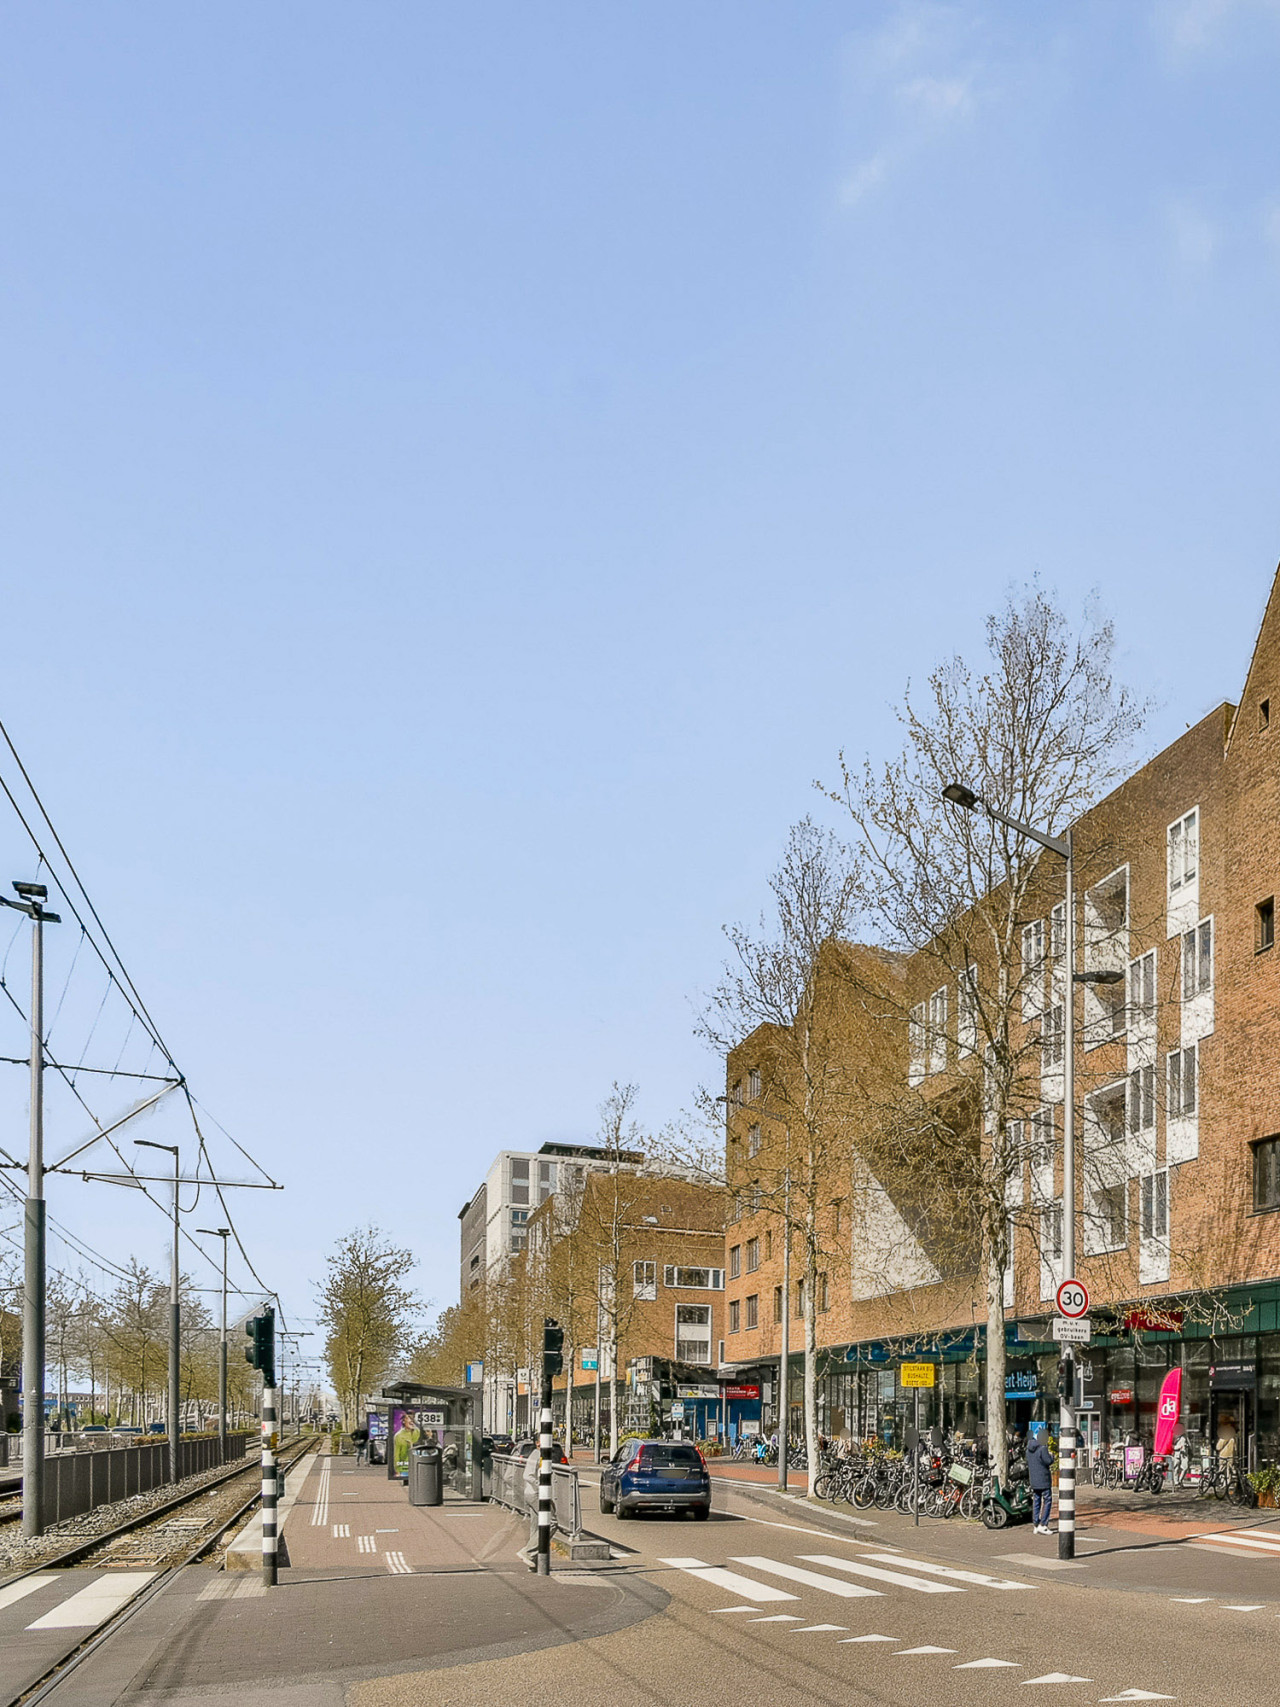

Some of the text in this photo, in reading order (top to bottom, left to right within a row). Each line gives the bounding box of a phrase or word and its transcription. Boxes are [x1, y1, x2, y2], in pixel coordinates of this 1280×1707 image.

[1062, 1291, 1084, 1307] 30
[1016, 1370, 1037, 1390] Heijn
[1161, 1397, 1176, 1416] da
[417, 1414, 436, 1423] 538
